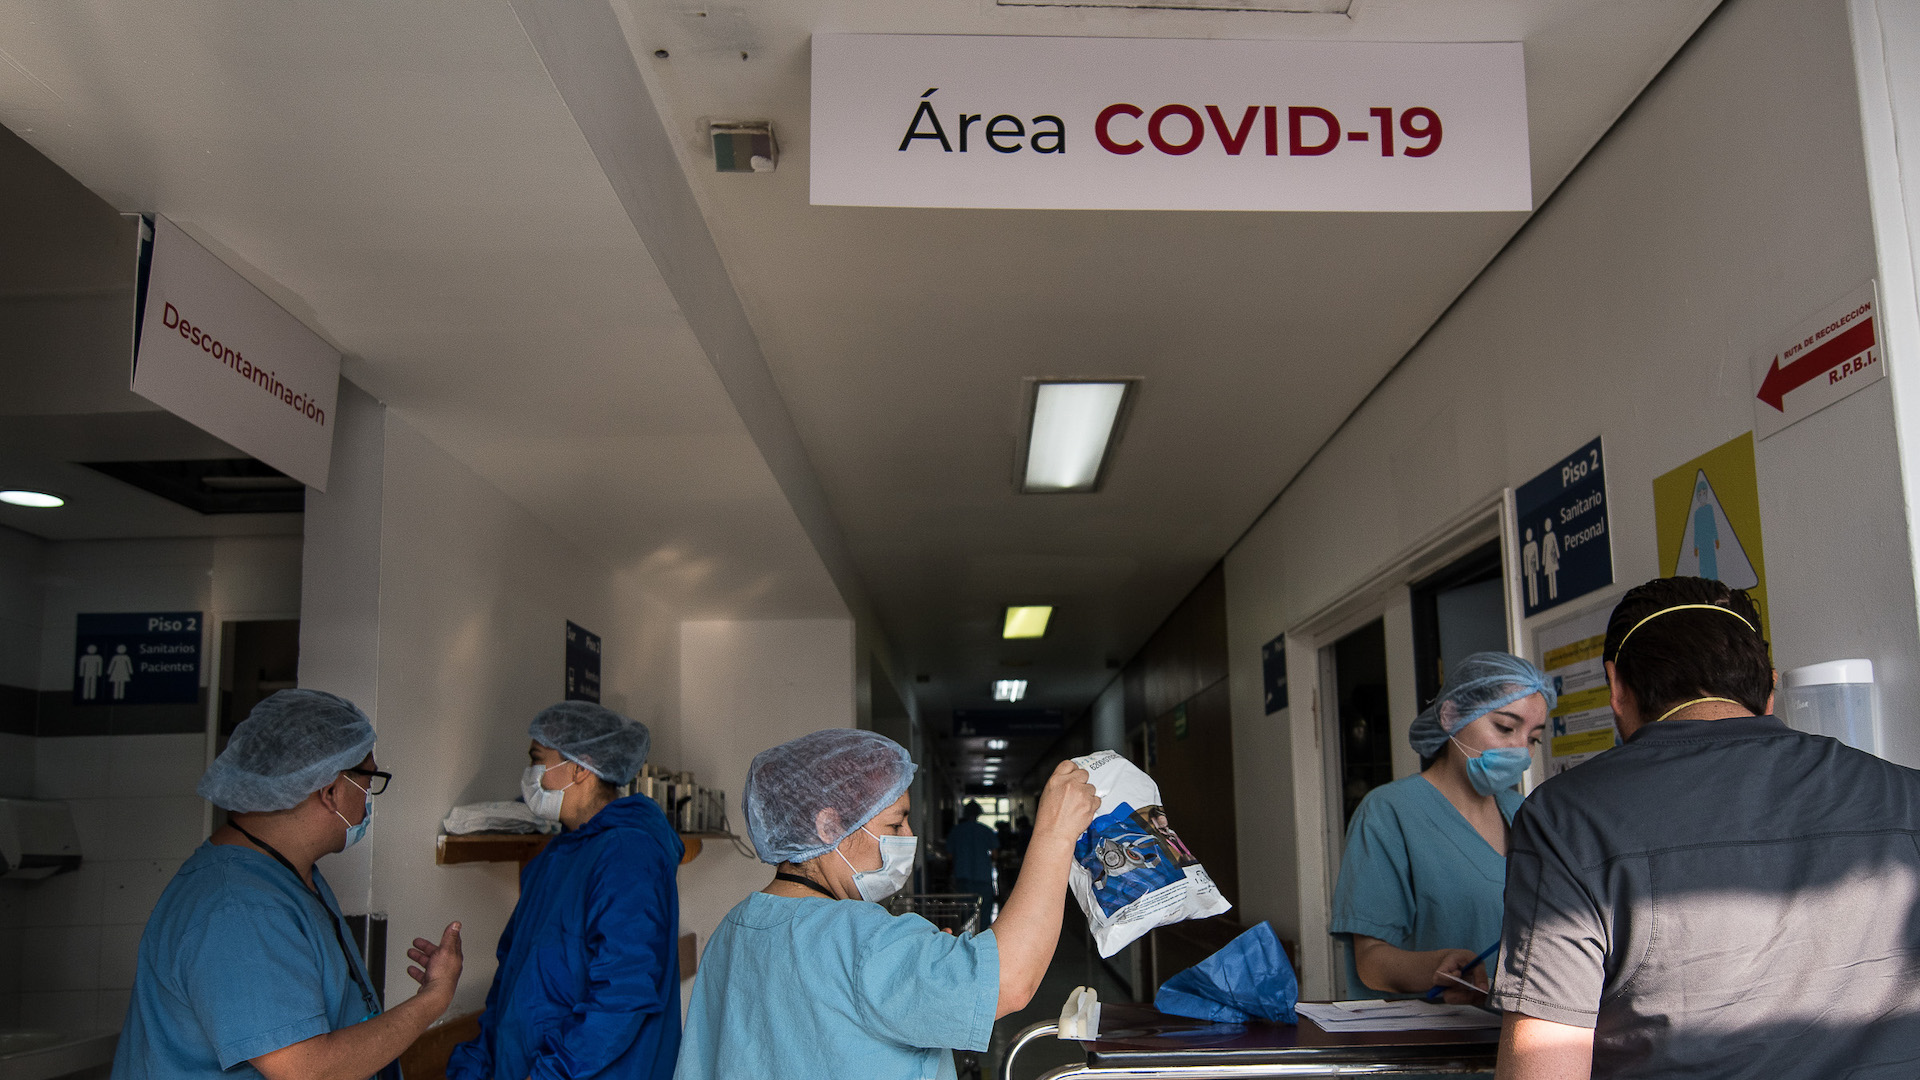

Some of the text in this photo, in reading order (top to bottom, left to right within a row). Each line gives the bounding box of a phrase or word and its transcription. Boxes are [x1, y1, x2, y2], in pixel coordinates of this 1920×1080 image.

[899, 88, 1444, 158] Área COVID-19
[1784, 302, 1871, 359] RUTA DE RECOLECCIÓN
[163, 301, 325, 426] Descontaminación
[1828, 351, 1877, 385] R.P.B.I.
[1562, 449, 1599, 488] Piso 2
[1560, 491, 1602, 525] Sanitario
[1564, 516, 1605, 551] Personal
[148, 617, 197, 631] Piso 2
[139, 643, 194, 653] Sanitarios
[140, 661, 194, 672] Pacientes
